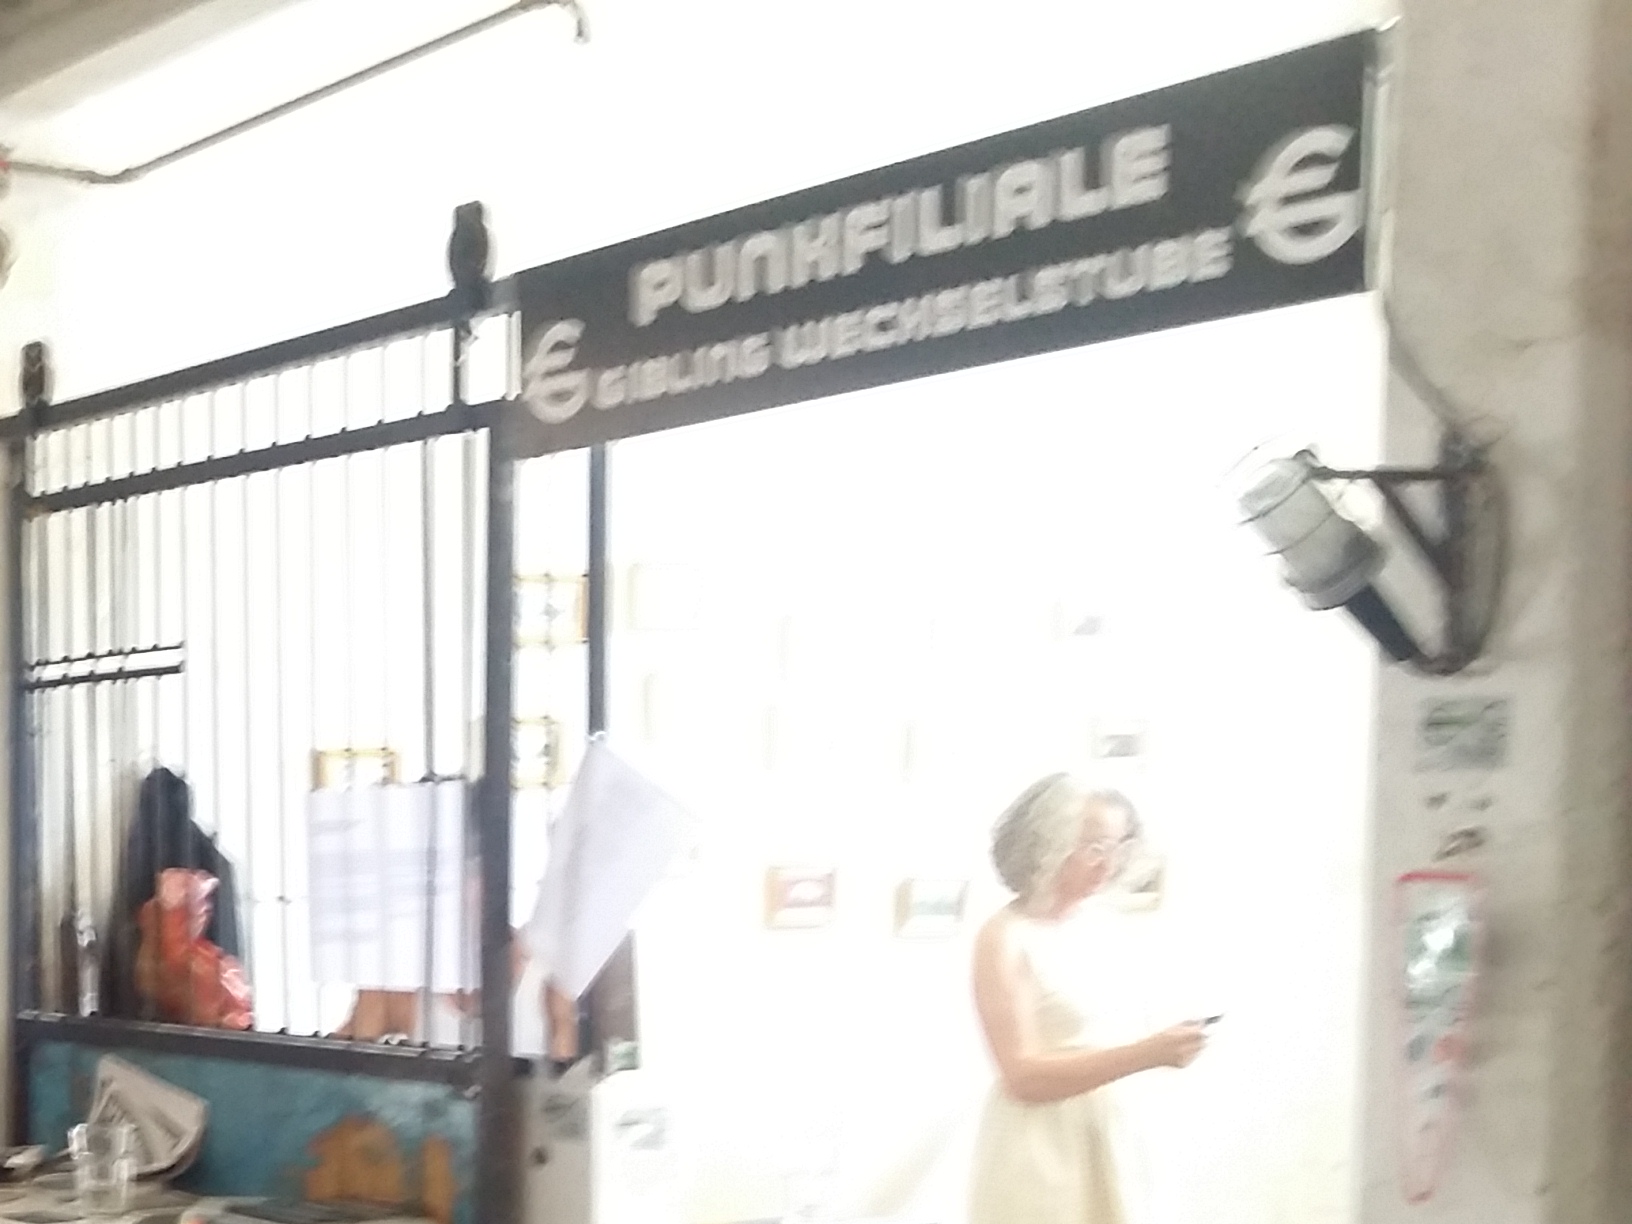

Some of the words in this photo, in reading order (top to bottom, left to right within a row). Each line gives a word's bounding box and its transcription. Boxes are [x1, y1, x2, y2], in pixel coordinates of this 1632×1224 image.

[591, 330, 771, 410] GIBLING
[773, 225, 1234, 371] WECHSELSTUBE
[628, 123, 1171, 327] PUNKFILIALE
